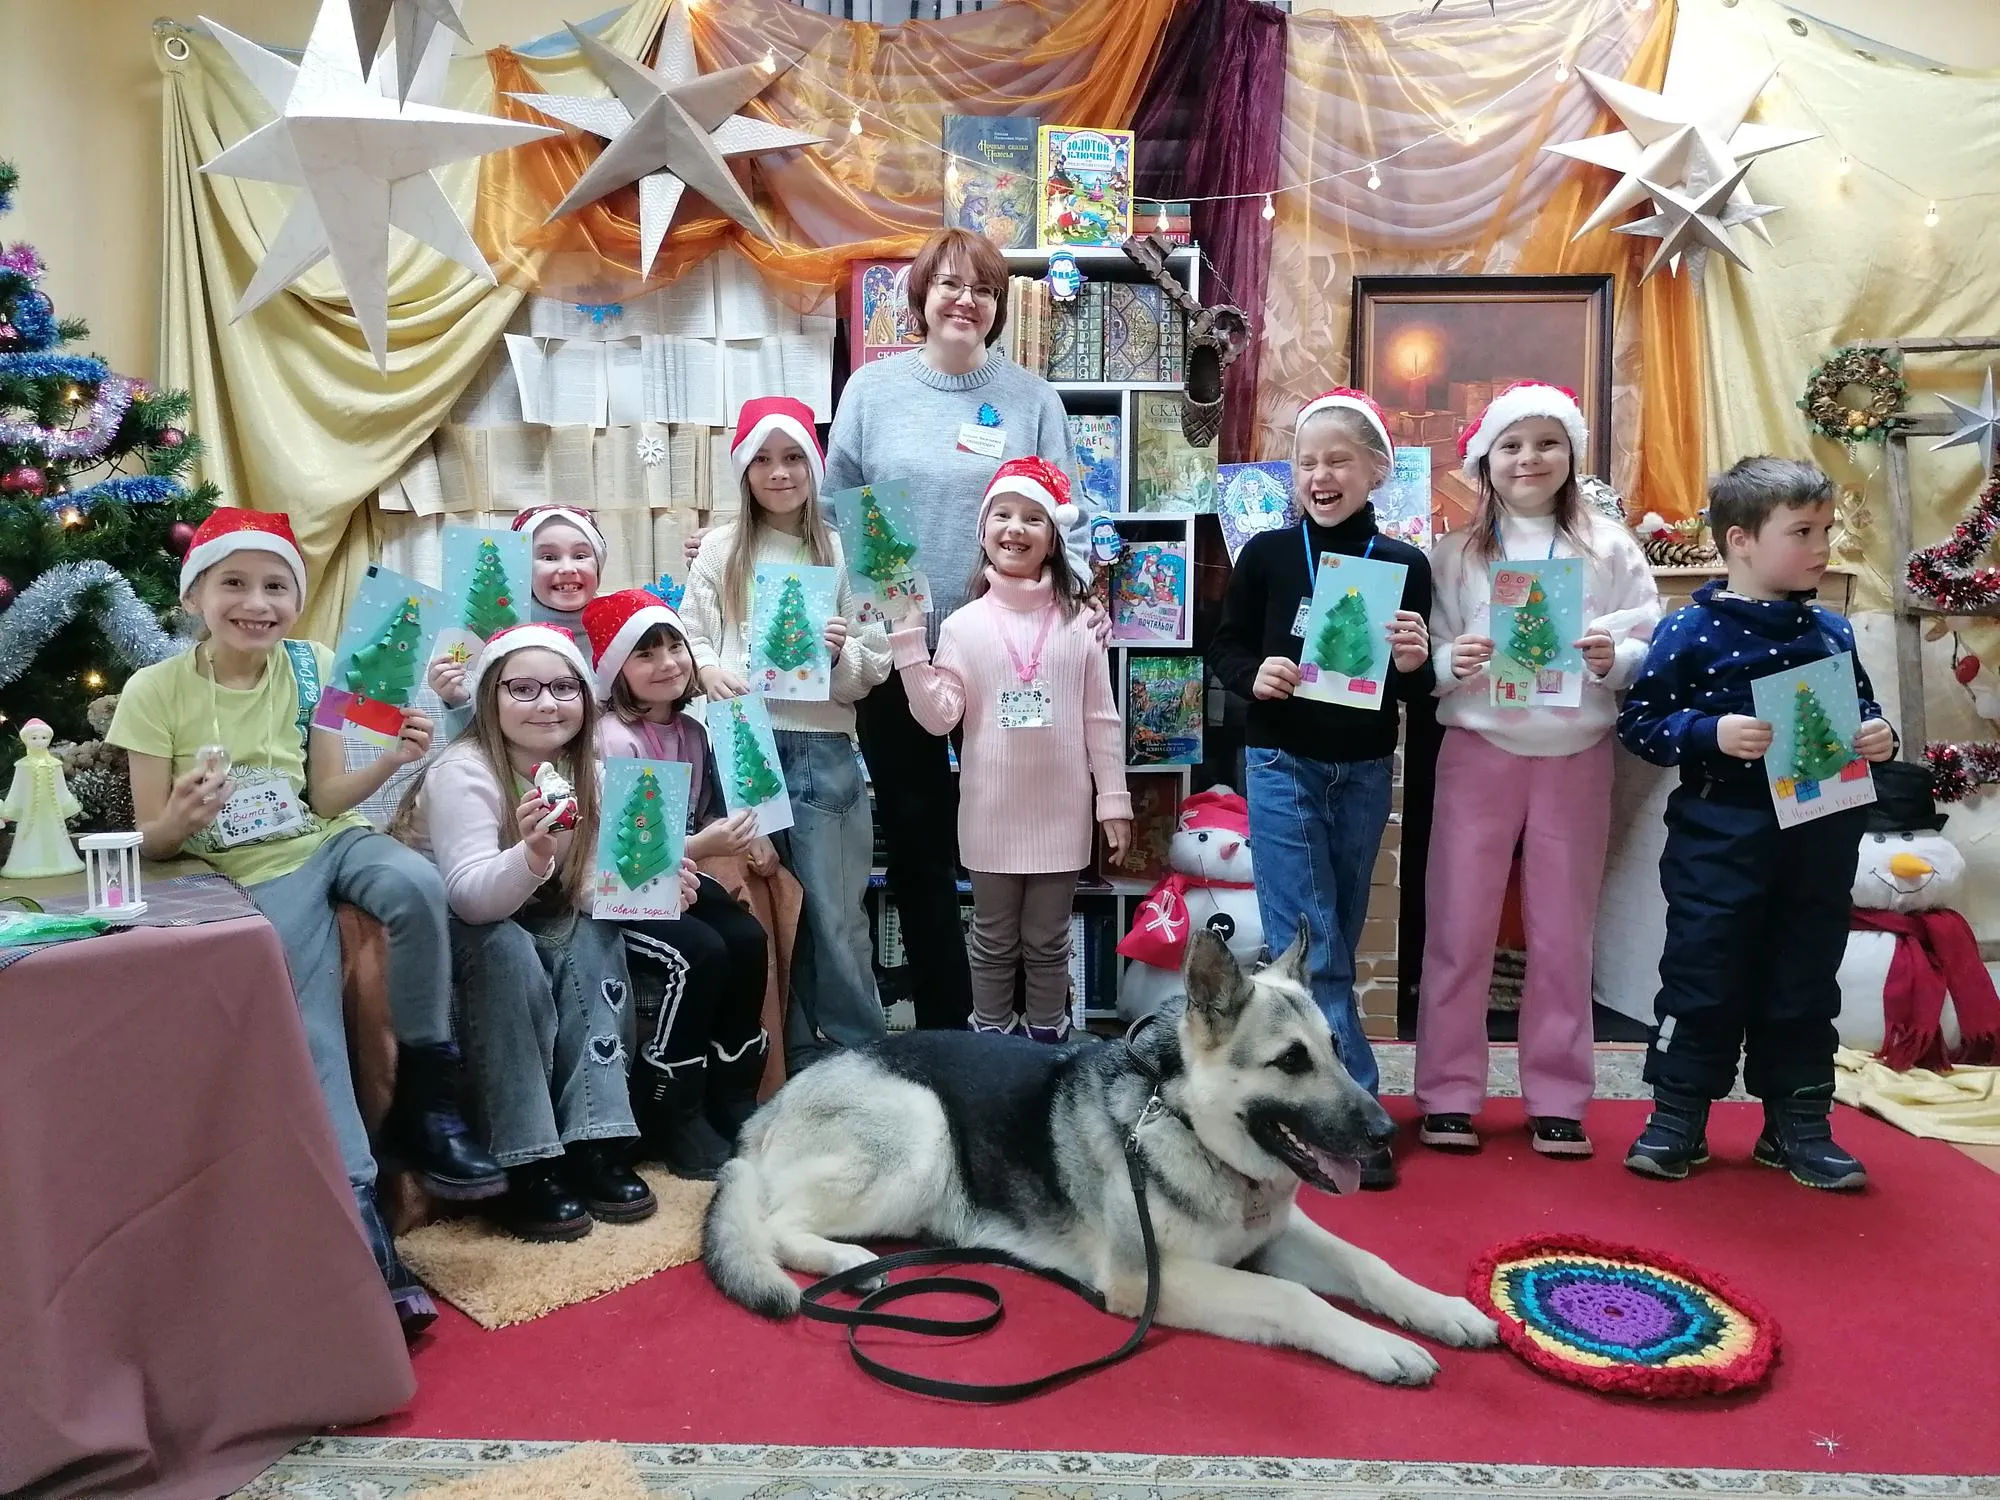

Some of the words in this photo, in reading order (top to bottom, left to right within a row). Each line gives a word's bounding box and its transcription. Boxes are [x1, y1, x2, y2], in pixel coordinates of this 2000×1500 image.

[1066, 139, 1109, 154] ЗОЛОТОЙ
[1150, 404, 1182, 417] СКА
[1084, 422, 1113, 433] ЗИМА
[232, 807, 269, 823] Вита
